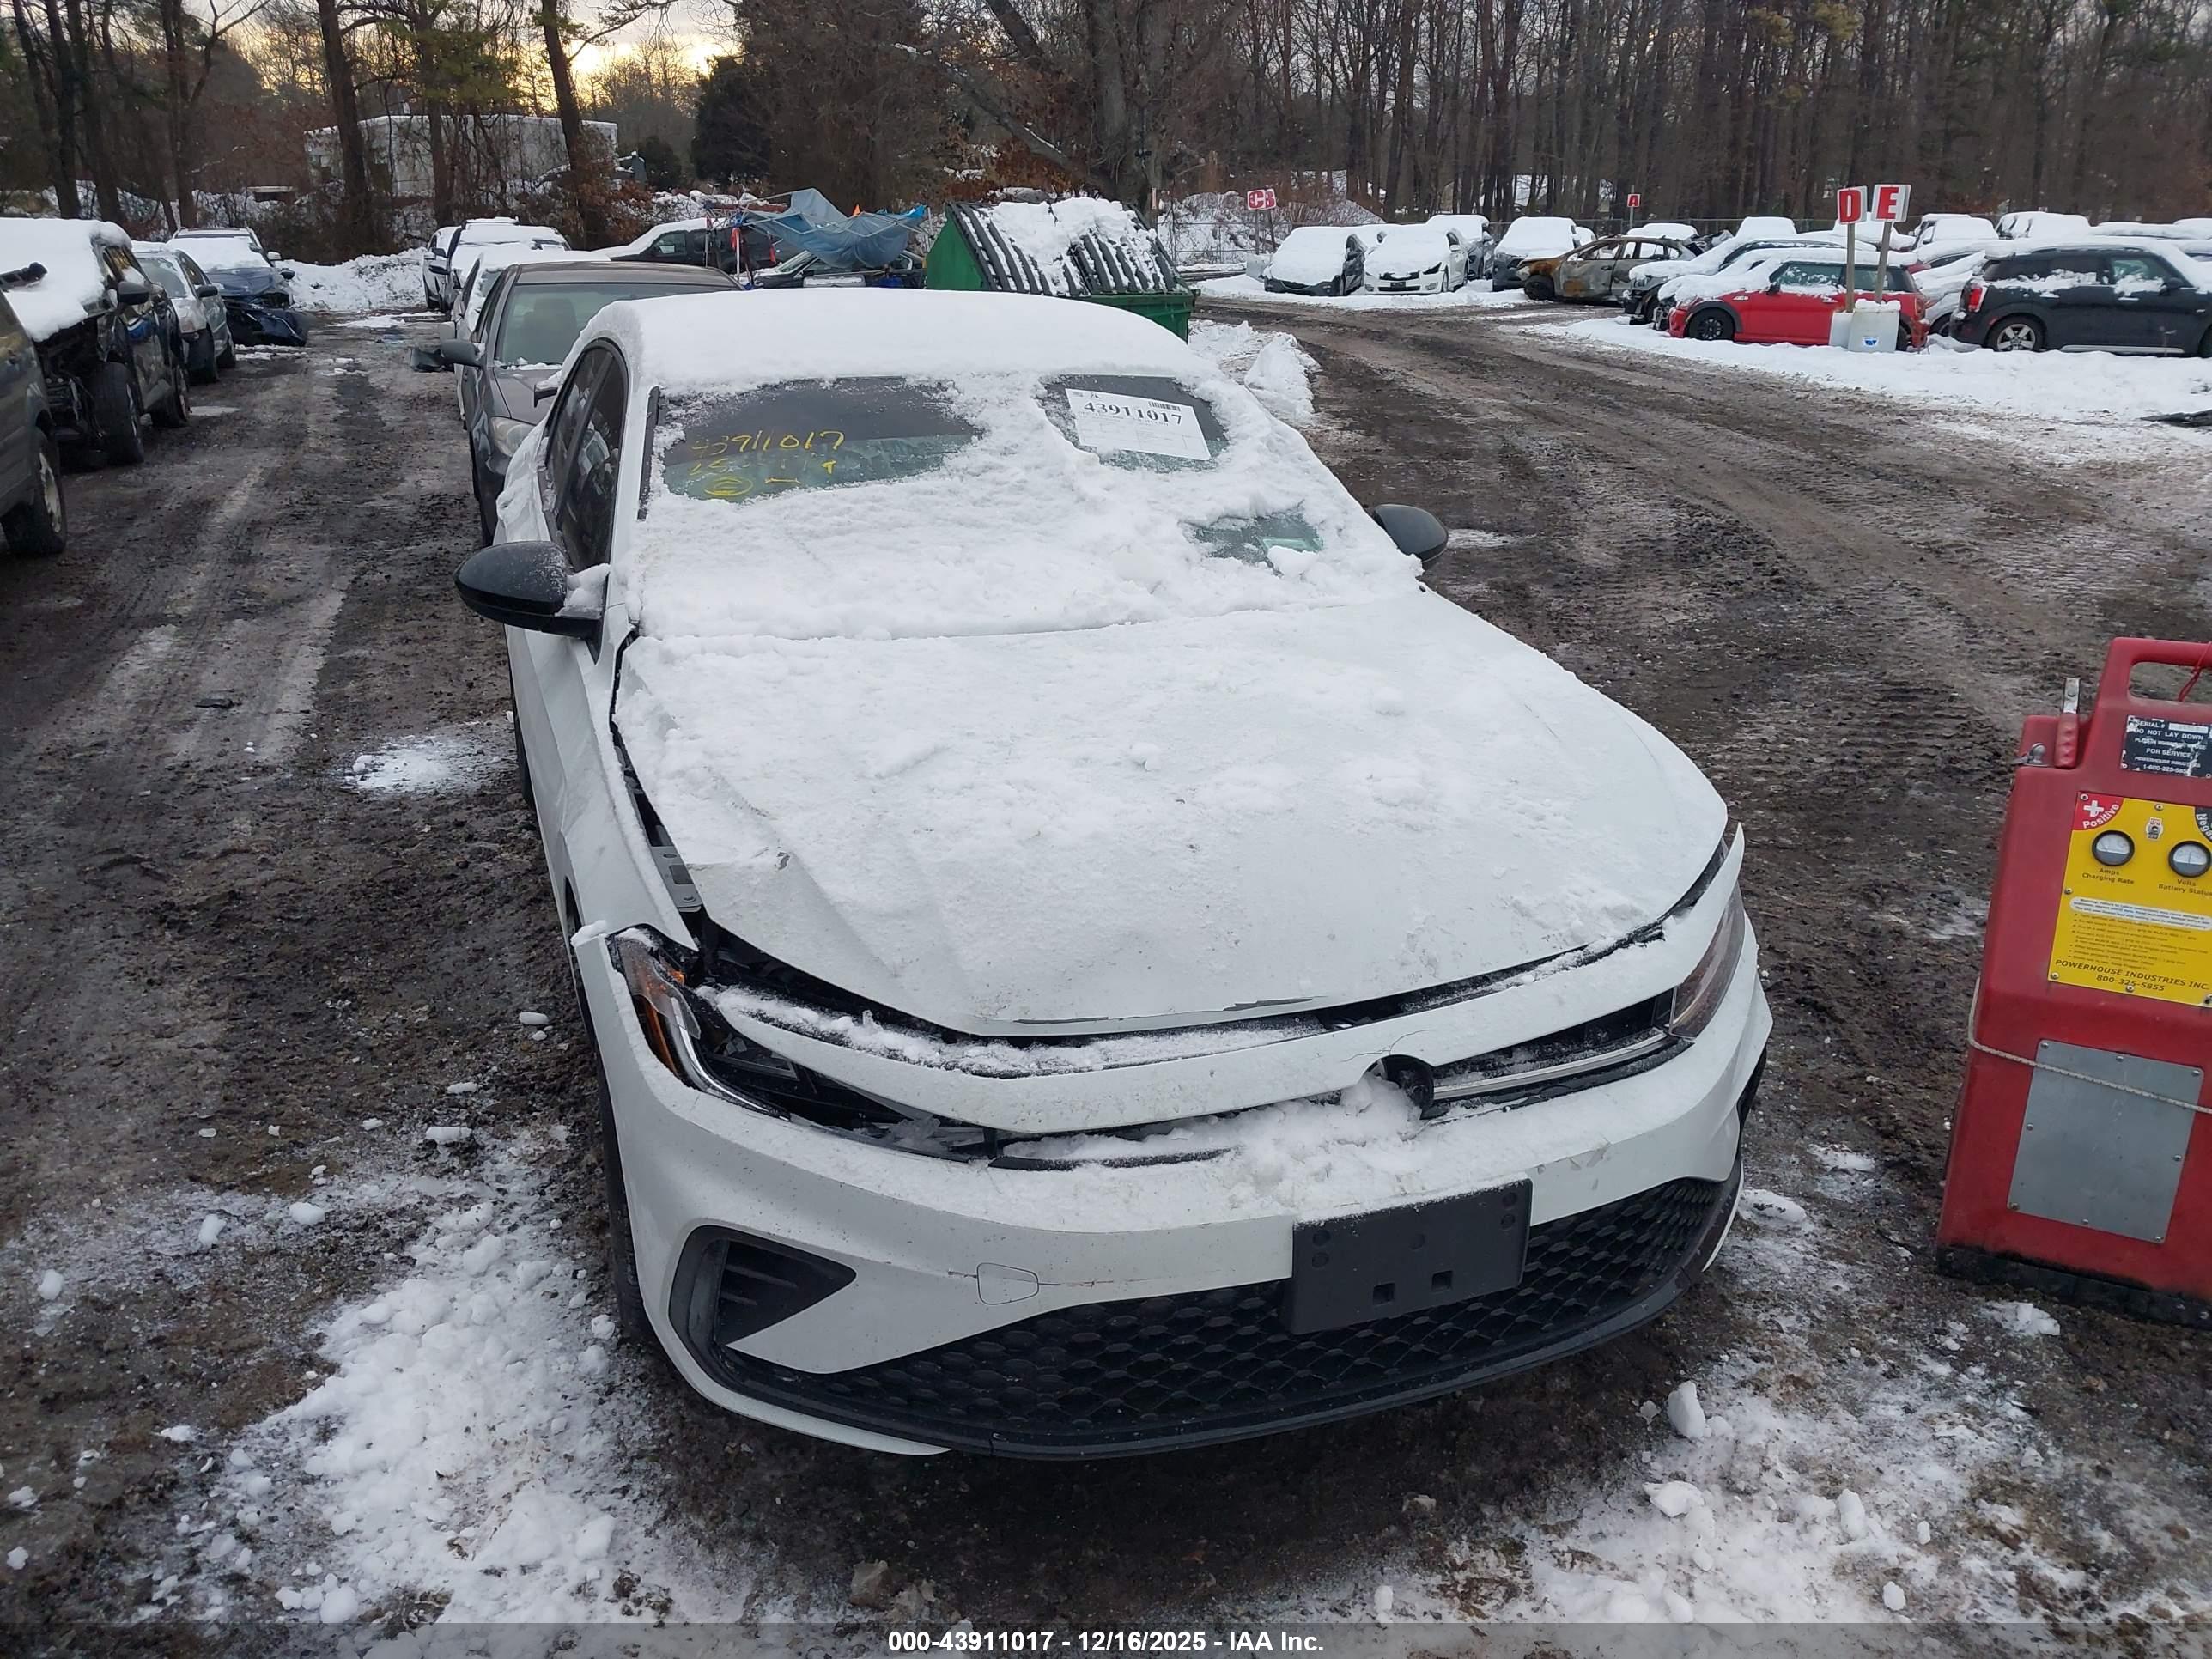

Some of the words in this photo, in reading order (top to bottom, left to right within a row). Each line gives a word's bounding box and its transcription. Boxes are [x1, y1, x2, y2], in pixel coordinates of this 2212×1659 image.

[1628, 195, 1639, 206] A
[1838, 189, 1862, 223] D
[1876, 186, 1899, 220] E
[1084, 402, 1182, 425] 43911017
[2182, 732, 2204, 741] DOWN
[2082, 803, 2120, 830] Positive
[2082, 872, 2116, 883] Charging
[2118, 877, 2135, 885] Rate
[2099, 867, 2120, 876] Amps
[2158, 884, 2186, 894] Battery
[2055, 959, 2123, 976] POWERHOUSE
[2125, 970, 2186, 986] INDUSTRIES
[2189, 981, 2210, 991] INC.
[2096, 975, 2166, 992] 800-325-5855
